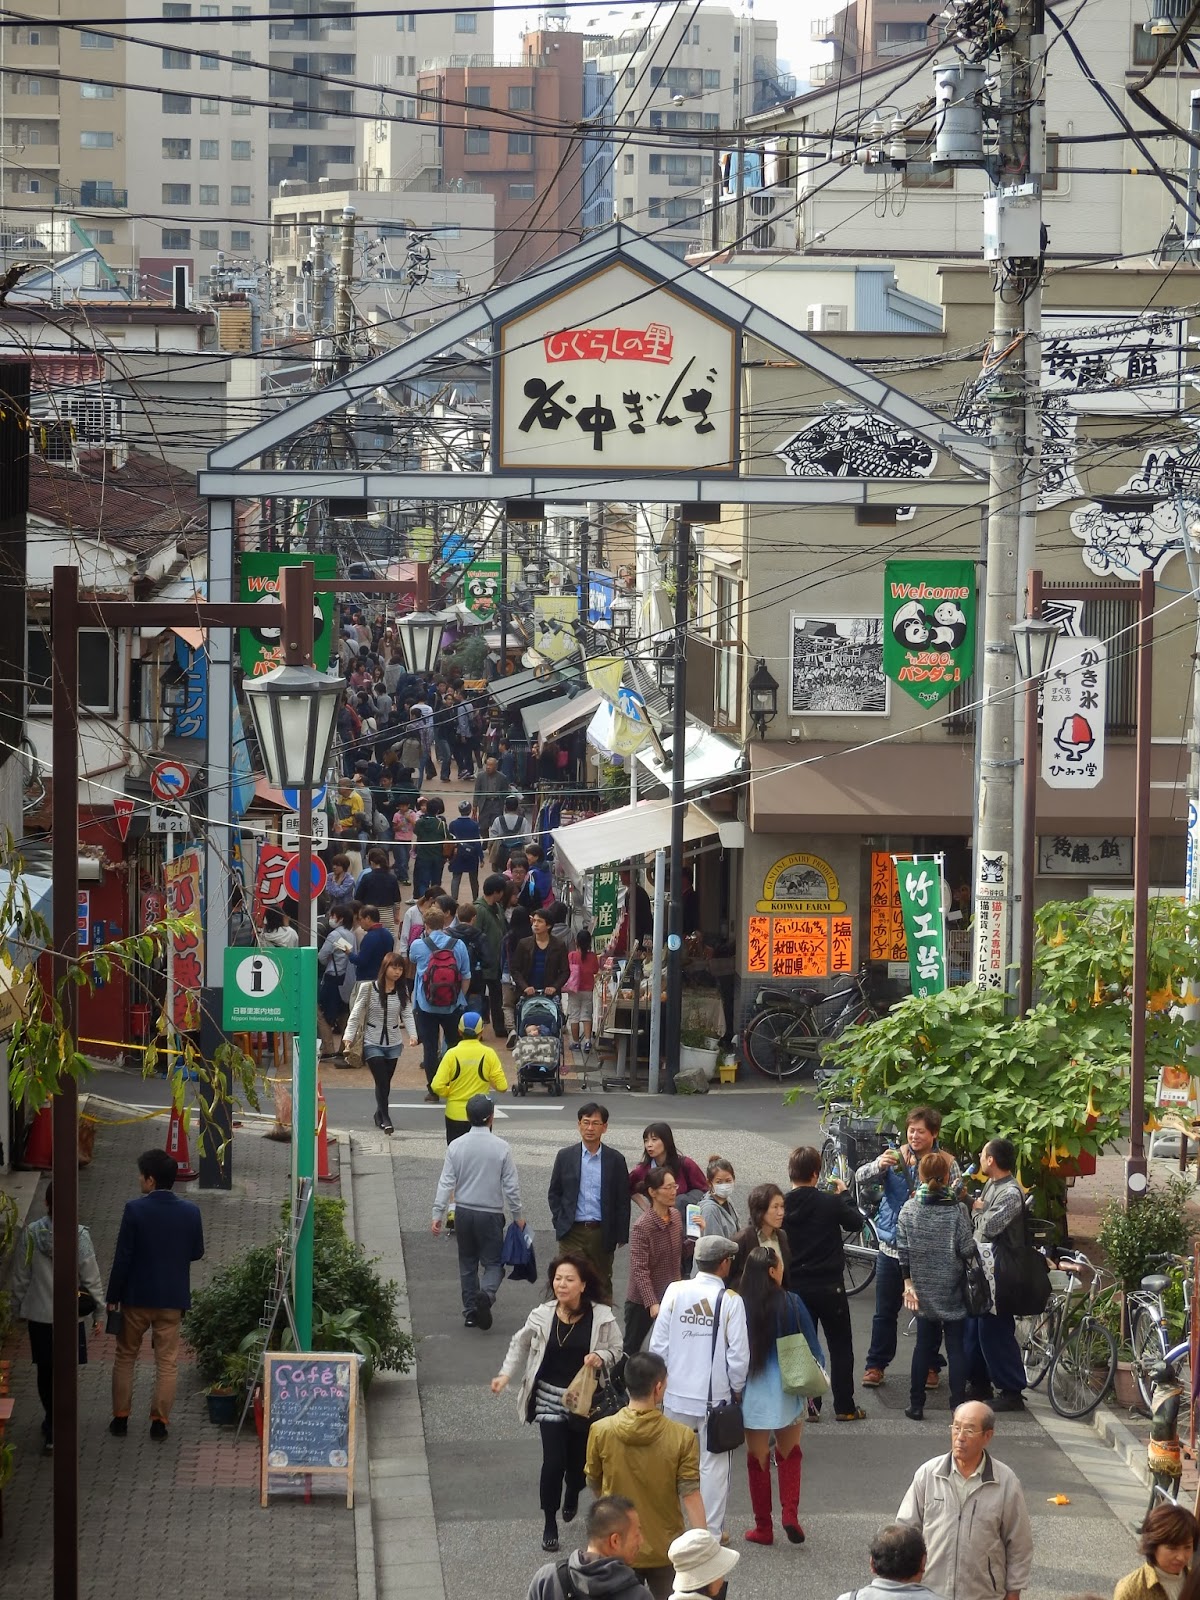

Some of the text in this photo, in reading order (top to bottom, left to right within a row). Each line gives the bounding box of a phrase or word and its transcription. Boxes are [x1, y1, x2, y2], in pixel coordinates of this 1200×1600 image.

[546, 323, 673, 364] ひぐらしの里
[518, 356, 718, 451] 谷中ぎんざ
[890, 582, 970, 599] Welcome
[1079, 648, 1099, 709] かき氷
[1048, 763, 1098, 777] ひみつ堂
[766, 856, 836, 890] GENUINE DAIRY PRODUCTS
[771, 903, 831, 911] KOIWAI FARM
[905, 870, 940, 980] 竹工芸
[680, 1313, 720, 1328] adida
[275, 1364, 334, 1386] Café
